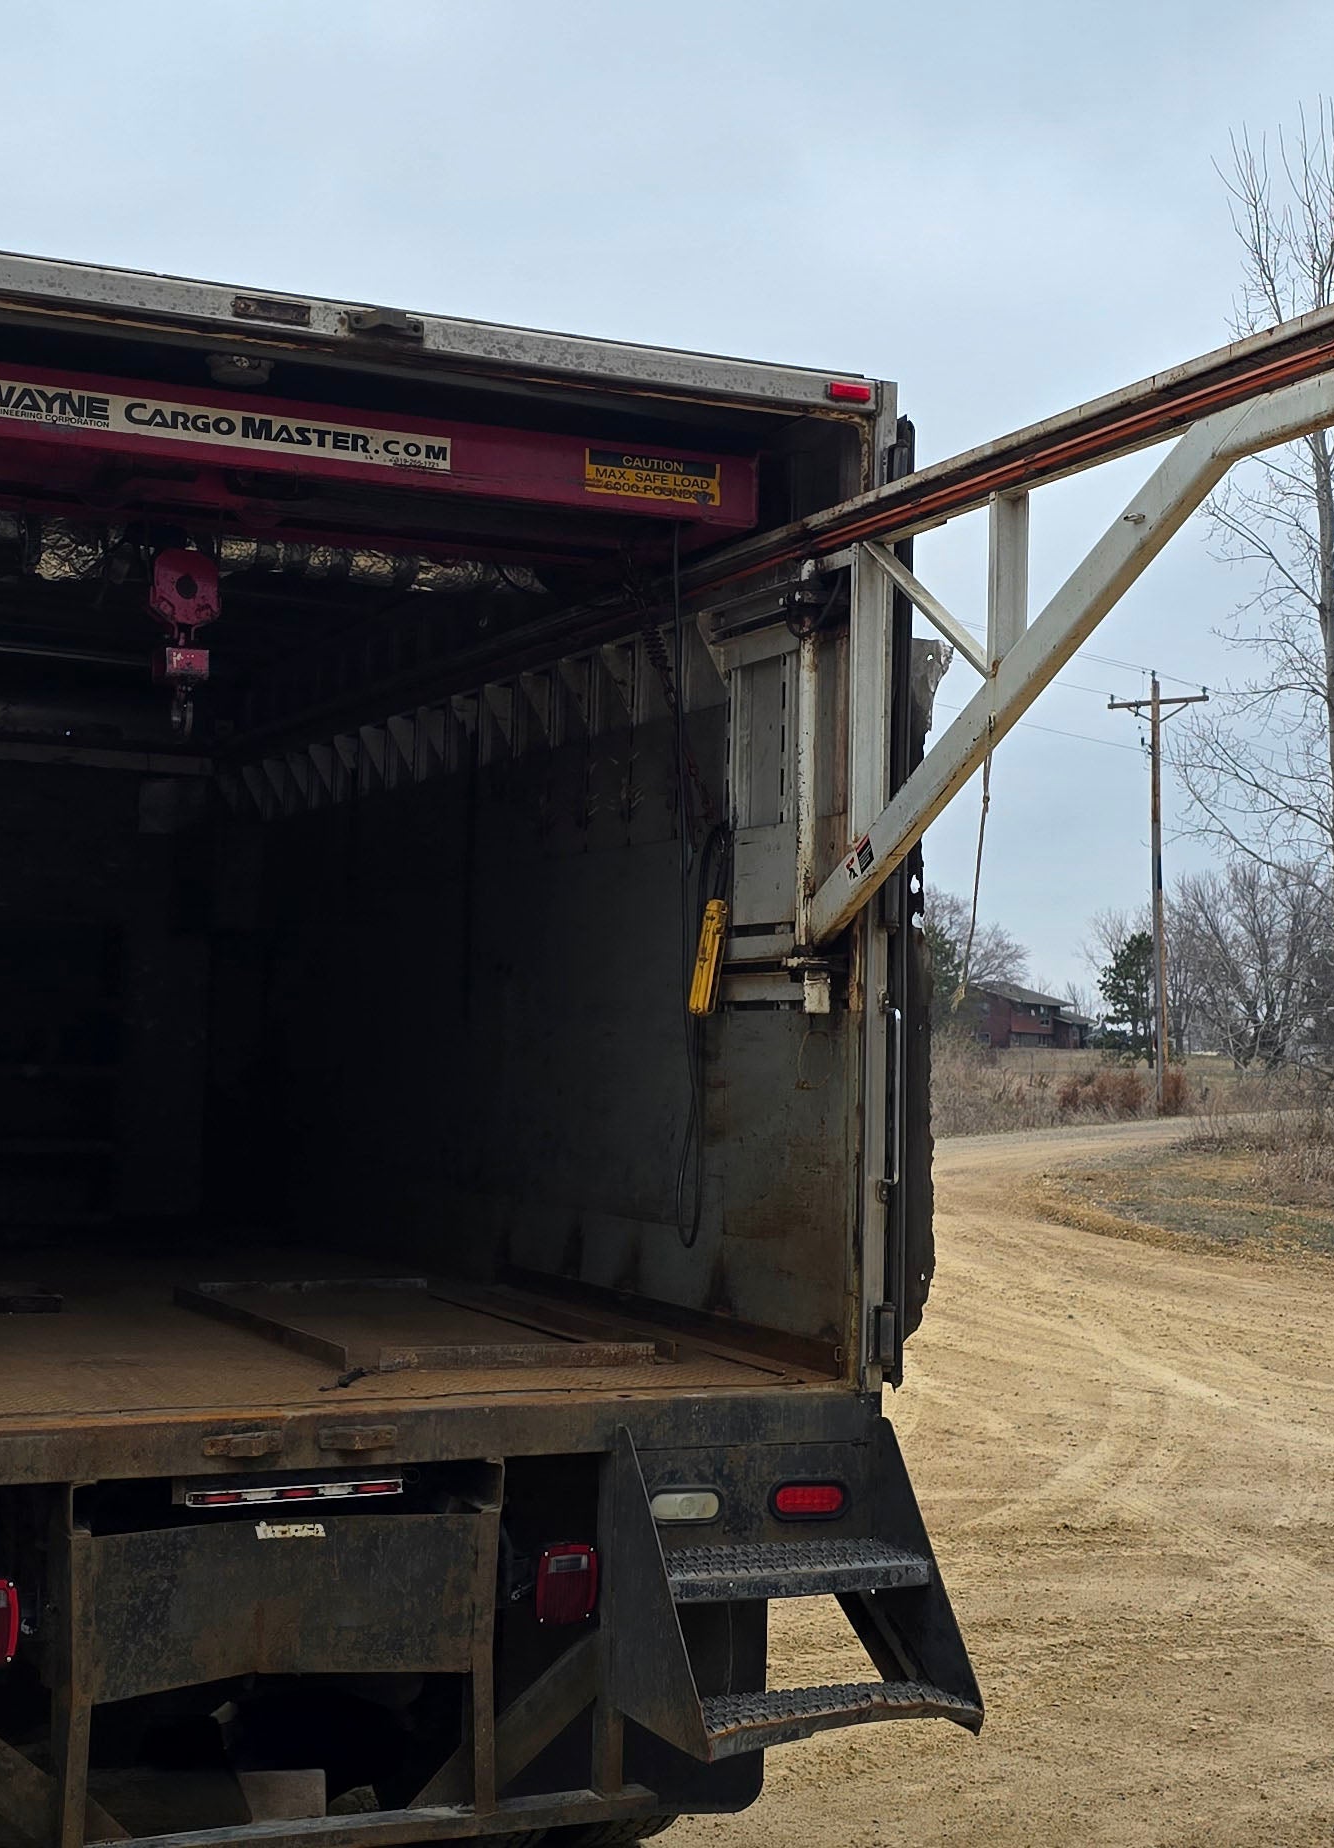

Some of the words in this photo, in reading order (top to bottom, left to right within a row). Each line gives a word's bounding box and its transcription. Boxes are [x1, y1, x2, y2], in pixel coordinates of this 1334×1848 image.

[45, 414, 109, 428] CORPORATION
[124, 402, 236, 436] CARGO
[622, 455, 684, 473] CAUTION
[595, 467, 630, 481] MAX.
[634, 472, 669, 486] SAFE
[674, 477, 710, 490] LOAD
